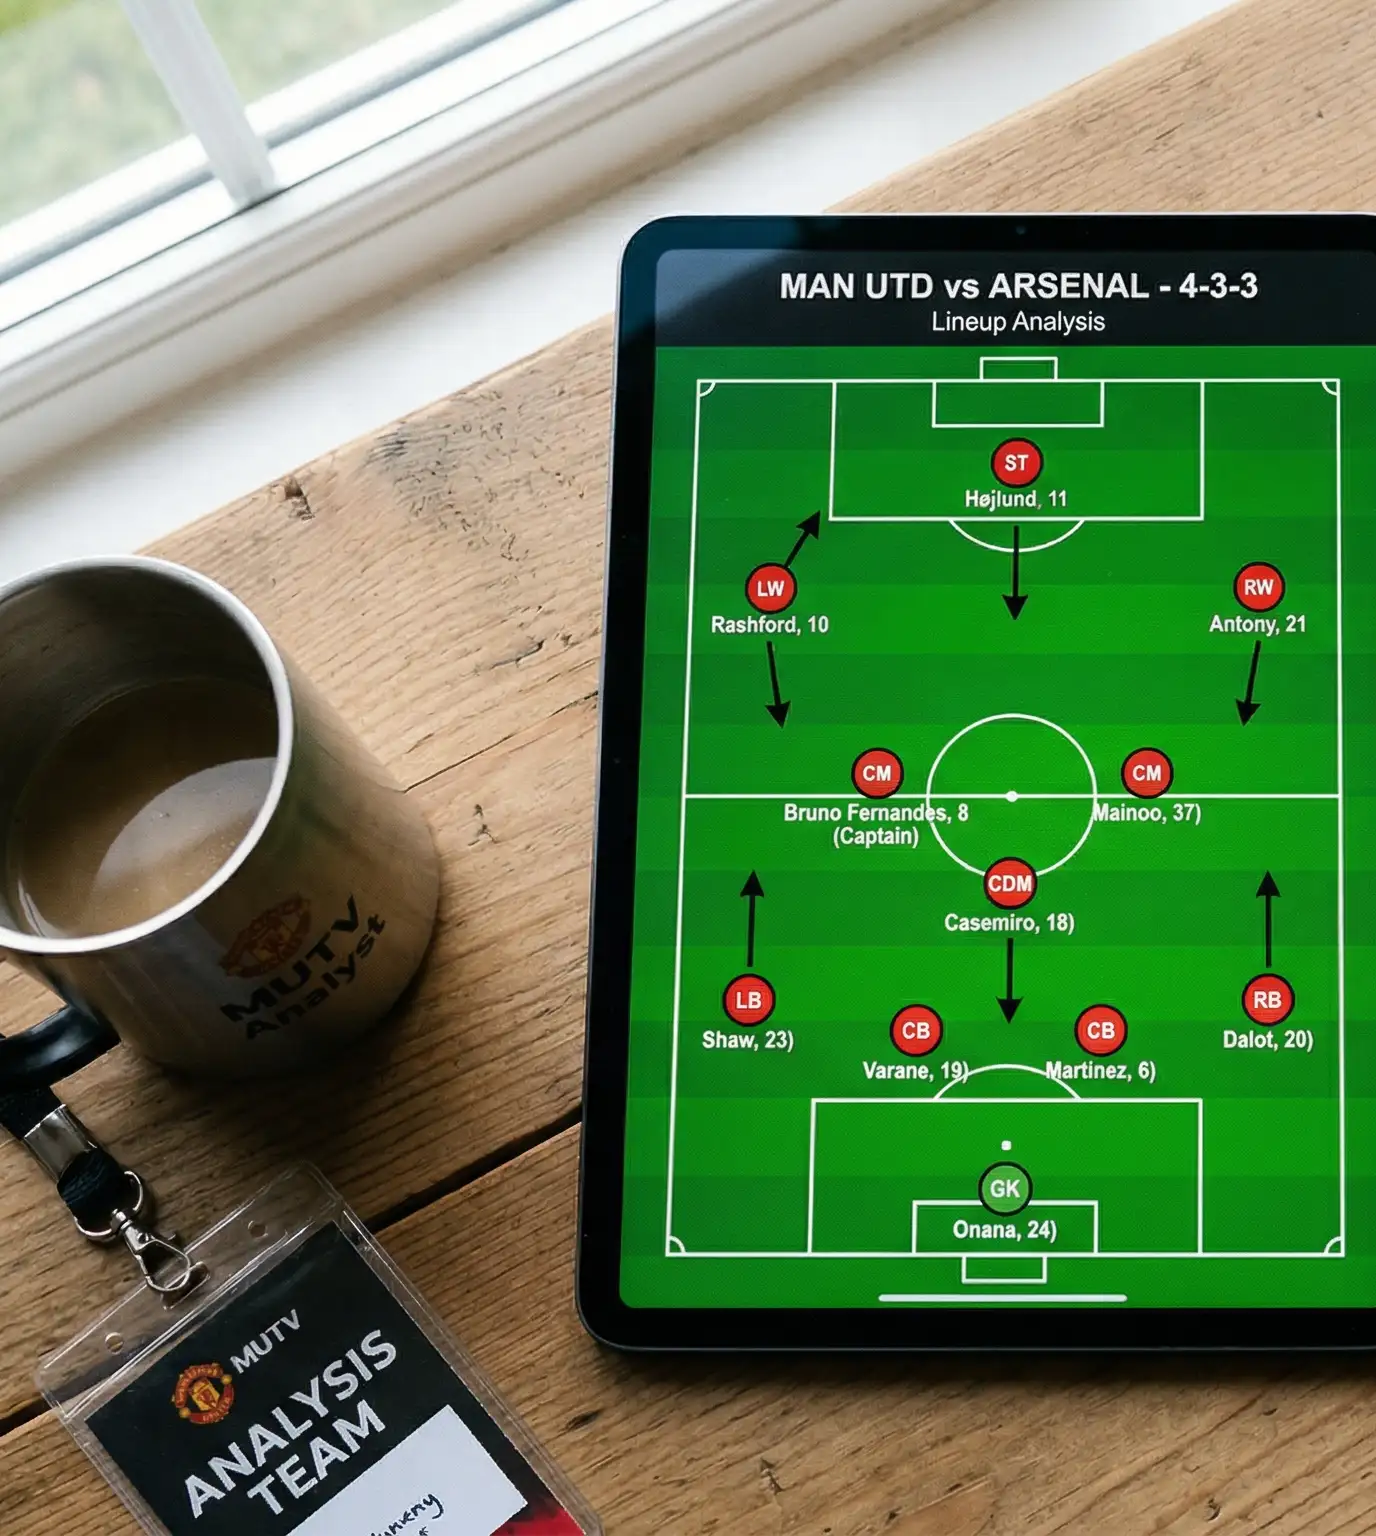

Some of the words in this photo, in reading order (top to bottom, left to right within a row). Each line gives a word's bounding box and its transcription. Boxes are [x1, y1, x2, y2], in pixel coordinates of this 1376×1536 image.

[780, 273, 854, 298] MAN
[866, 274, 933, 298] UTD
[945, 279, 978, 298] vs
[989, 273, 1149, 298] ARSENAL
[1179, 273, 1258, 298] 4-3-3
[932, 311, 1006, 336] Lineup
[1012, 311, 1105, 336] Analysis
[1005, 454, 1028, 471] ST
[965, 490, 1042, 510] Højlund,
[1049, 490, 1067, 507] 11
[758, 580, 784, 596] LW
[1245, 579, 1273, 595] RW
[712, 615, 802, 636] Rashford,
[808, 615, 829, 633] 10
[1209, 616, 1280, 636] Antony,
[1286, 615, 1306, 633] 21
[863, 766, 891, 781] CM
[1133, 765, 1161, 781] CM
[785, 804, 842, 822] Bruno
[848, 804, 952, 825] Fernandes,
[958, 804, 968, 822] 8
[1094, 804, 1166, 824] Mainoo,
[1173, 803, 1201, 825] 37)
[833, 826, 919, 849] (Captain)
[989, 875, 1032, 892] CDM
[945, 913, 1040, 934] Casemiro,
[1047, 913, 1074, 935] 18)
[220, 894, 359, 1021] MUTV
[246, 914, 385, 1039] Analyst
[737, 992, 761, 1009] LB
[1254, 992, 1281, 1008] RB
[702, 1030, 758, 1051] Shaw,
[765, 1030, 794, 1052] 23)
[902, 1022, 930, 1039] CB
[1087, 1022, 1114, 1039] CB
[1224, 1030, 1278, 1050] Dalot,
[1285, 1030, 1313, 1052] 20)
[863, 1062, 934, 1082] Varane,
[942, 1061, 968, 1082] 19)
[1138, 1061, 1155, 1082] 6)
[990, 1181, 1020, 1197] GK
[954, 1221, 1022, 1242] Onana,
[1028, 1221, 1056, 1242] 24)
[230, 1309, 301, 1374] MUTV
[183, 1330, 397, 1519] ANALYSIS
[247, 1400, 385, 1516] TEAM
